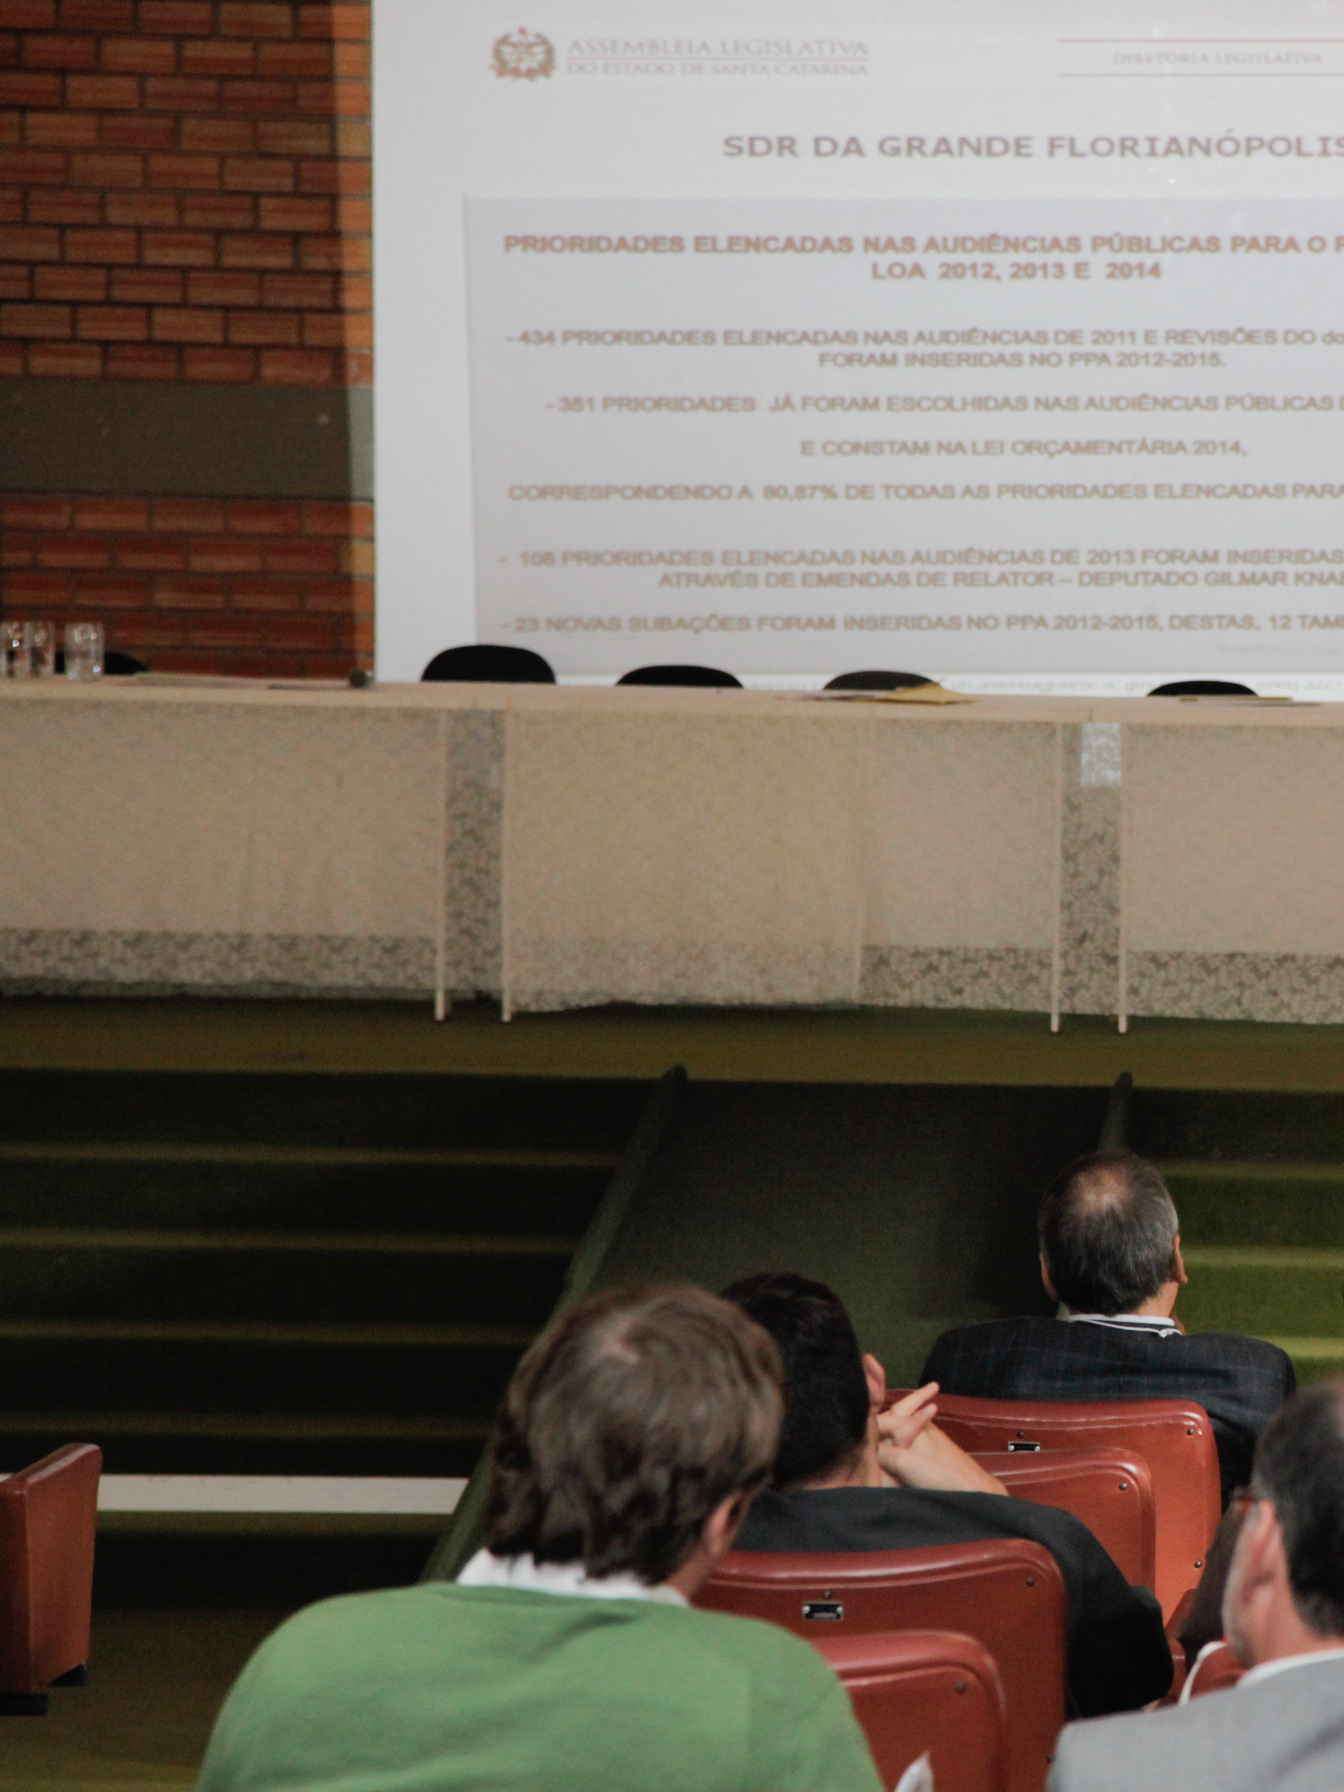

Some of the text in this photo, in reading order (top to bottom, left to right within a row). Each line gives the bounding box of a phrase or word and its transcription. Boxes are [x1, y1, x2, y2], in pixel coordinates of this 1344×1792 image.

[723, 136, 799, 158] SDR
[813, 136, 865, 158] DA
[878, 136, 1032, 158] GRANDE
[504, 235, 685, 254] PRIORIDADES
[694, 236, 854, 254] ELENCADAS
[863, 236, 917, 254] NAS
[923, 233, 1082, 254] AUDIÊNCIAS
[1091, 233, 1221, 254] PÚBLICAS
[1230, 235, 1301, 254] PARA
[1307, 236, 1327, 253] O
[872, 261, 1162, 282] LOA 2012, 2013 E 2014
[518, 330, 556, 345] 434
[561, 330, 717, 346] PRIORIDADES
[723, 330, 858, 346] ELENCADAS
[863, 330, 909, 346] NAS
[913, 327, 1049, 345] AUDIÊNCIAS
[1054, 330, 1083, 345] DE
[1091, 330, 1136, 346] 2011
[1144, 330, 1157, 345] E
[1165, 327, 1278, 345] REVISÕES
[1283, 329, 1316, 345] DO
[819, 352, 898, 368] FORAM
[905, 352, 1023, 368] INSERIDAS
[1030, 352, 1062, 367] NO
[1069, 352, 1112, 366] PPA
[602, 396, 756, 413] PRIORIDADES
[769, 394, 796, 412] JÁ
[801, 396, 880, 412] FORAM
[886, 396, 1029, 412] ESCOLHIDAS
[1034, 396, 1080, 412] NAS
[1084, 392, 1219, 412] AUDIÊNCIAS
[1225, 394, 1334, 412] PÚBLICAS
[800, 440, 814, 456] E
[821, 440, 930, 456] CONSTAM
[936, 441, 968, 456] NA
[971, 440, 1005, 456] LEI
[1011, 438, 1188, 459] ORÇAMENTÁRIA
[508, 485, 733, 501] CORRESPONDENDO
[737, 485, 754, 500] A
[844, 484, 874, 500] DE
[880, 484, 956, 500] TODAS
[960, 484, 990, 500] AS
[997, 484, 1148, 500] PRIORIDADES
[1154, 484, 1287, 499] ELENCADAS
[561, 550, 715, 567] PRIORIDADES
[721, 550, 856, 566] ELENCADAS
[860, 550, 906, 566] NAS
[910, 547, 1045, 566] AUDIÊNCIAS
[1050, 549, 1079, 565] DE
[1087, 549, 1136, 565] 2013
[1141, 549, 1220, 565] FORAM
[1227, 549, 1344, 565] INSERIDAS
[658, 570, 759, 588] ATRAVÉS
[765, 572, 795, 588] DE
[801, 572, 911, 588] EMENDAS
[915, 572, 946, 587] DE
[953, 571, 1054, 587] RELATOR
[1078, 571, 1199, 587] DEPUTADO
[1204, 571, 1288, 587] GILMAR
[515, 617, 540, 632] 23
[545, 617, 622, 632] NOVAS
[628, 614, 752, 636] SUBAÇÕES
[757, 616, 836, 631] FORAM
[843, 615, 962, 631] INSERIDAS
[966, 615, 1000, 631] NO
[1006, 615, 1050, 630] PPA
[1269, 615, 1292, 630] 12
